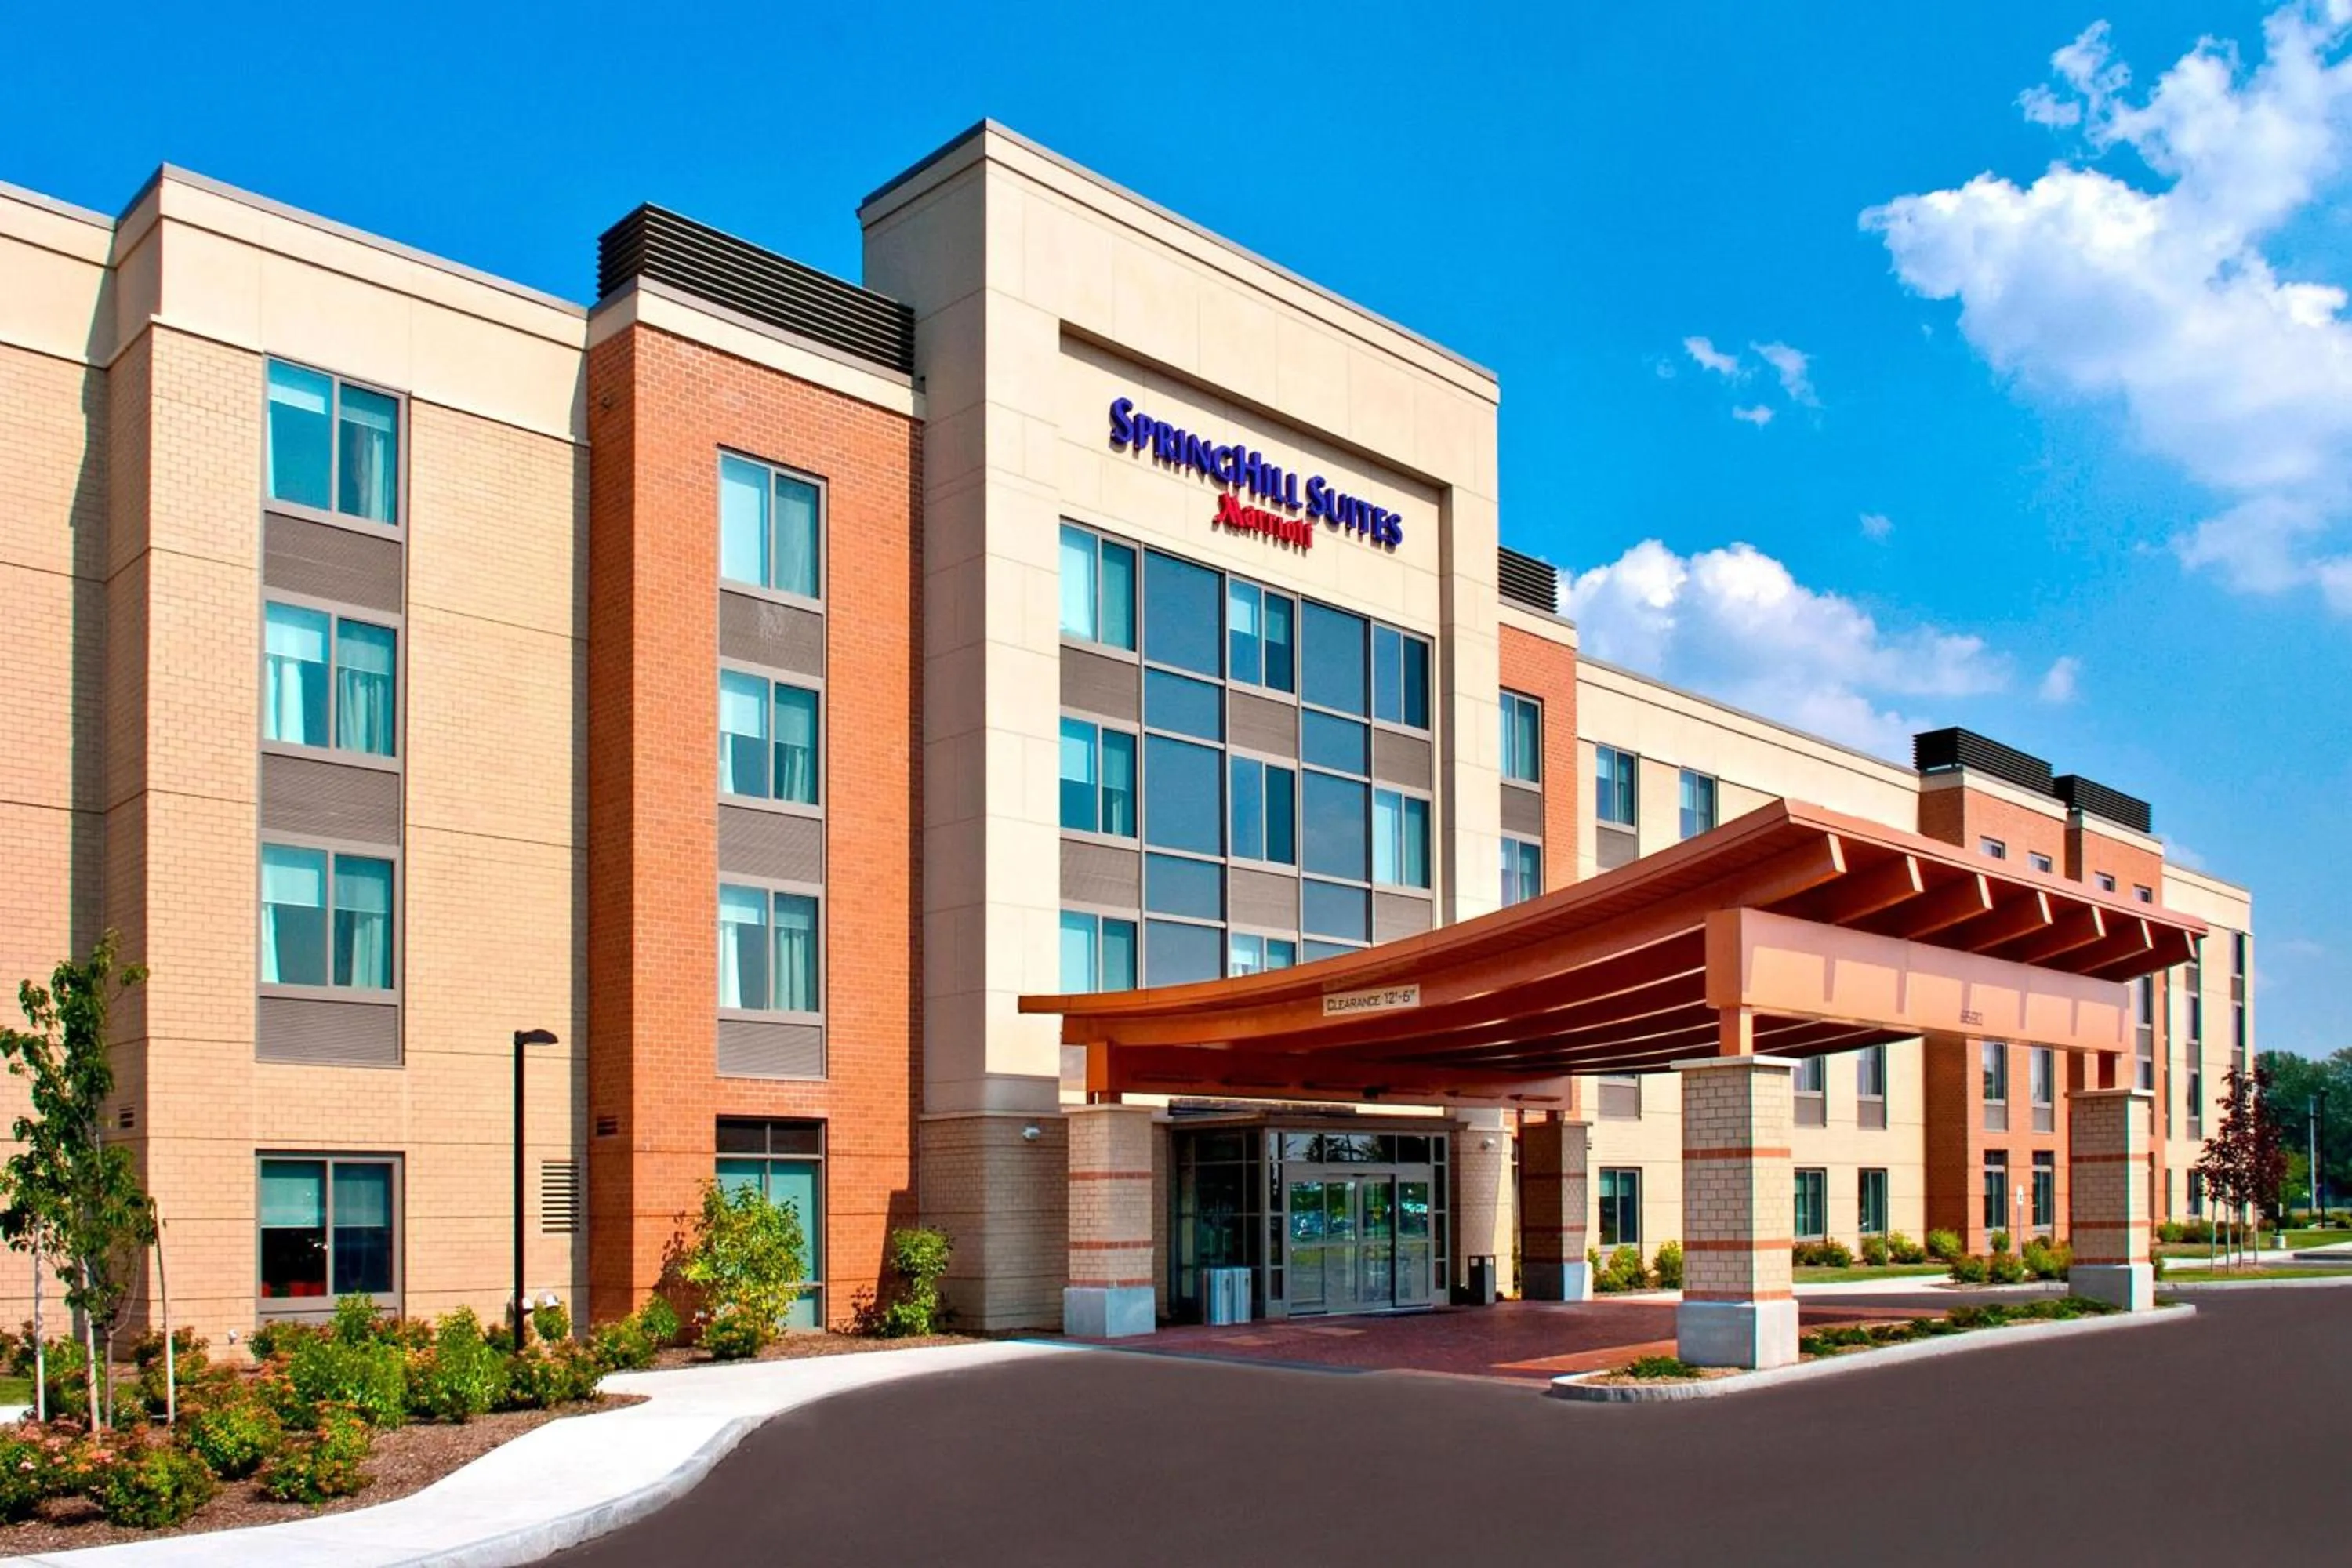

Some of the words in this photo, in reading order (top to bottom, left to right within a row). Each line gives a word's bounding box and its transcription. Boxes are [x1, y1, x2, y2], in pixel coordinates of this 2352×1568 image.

[1212, 492, 1313, 550] Marriott
[1306, 475, 1403, 546] SUITES
[1327, 995, 1381, 1011] CLEARANCE
